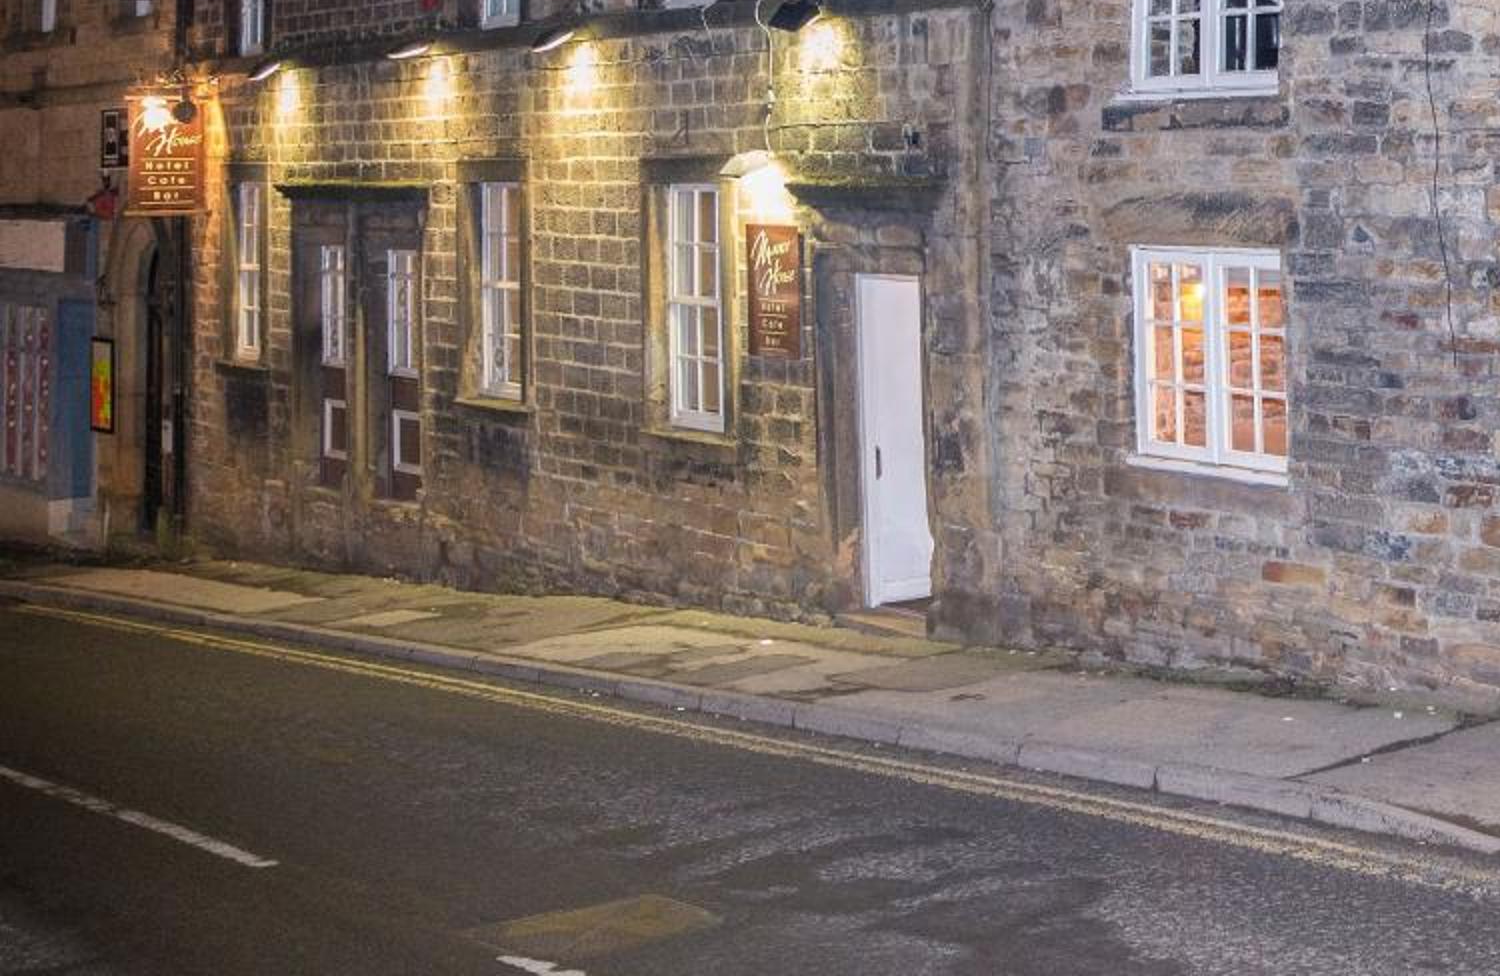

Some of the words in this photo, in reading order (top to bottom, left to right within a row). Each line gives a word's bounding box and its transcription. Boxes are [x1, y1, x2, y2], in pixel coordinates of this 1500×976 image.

[144, 161, 190, 171] Hotel
[146, 175, 186, 186] Cafe
[152, 190, 180, 201] Bar
